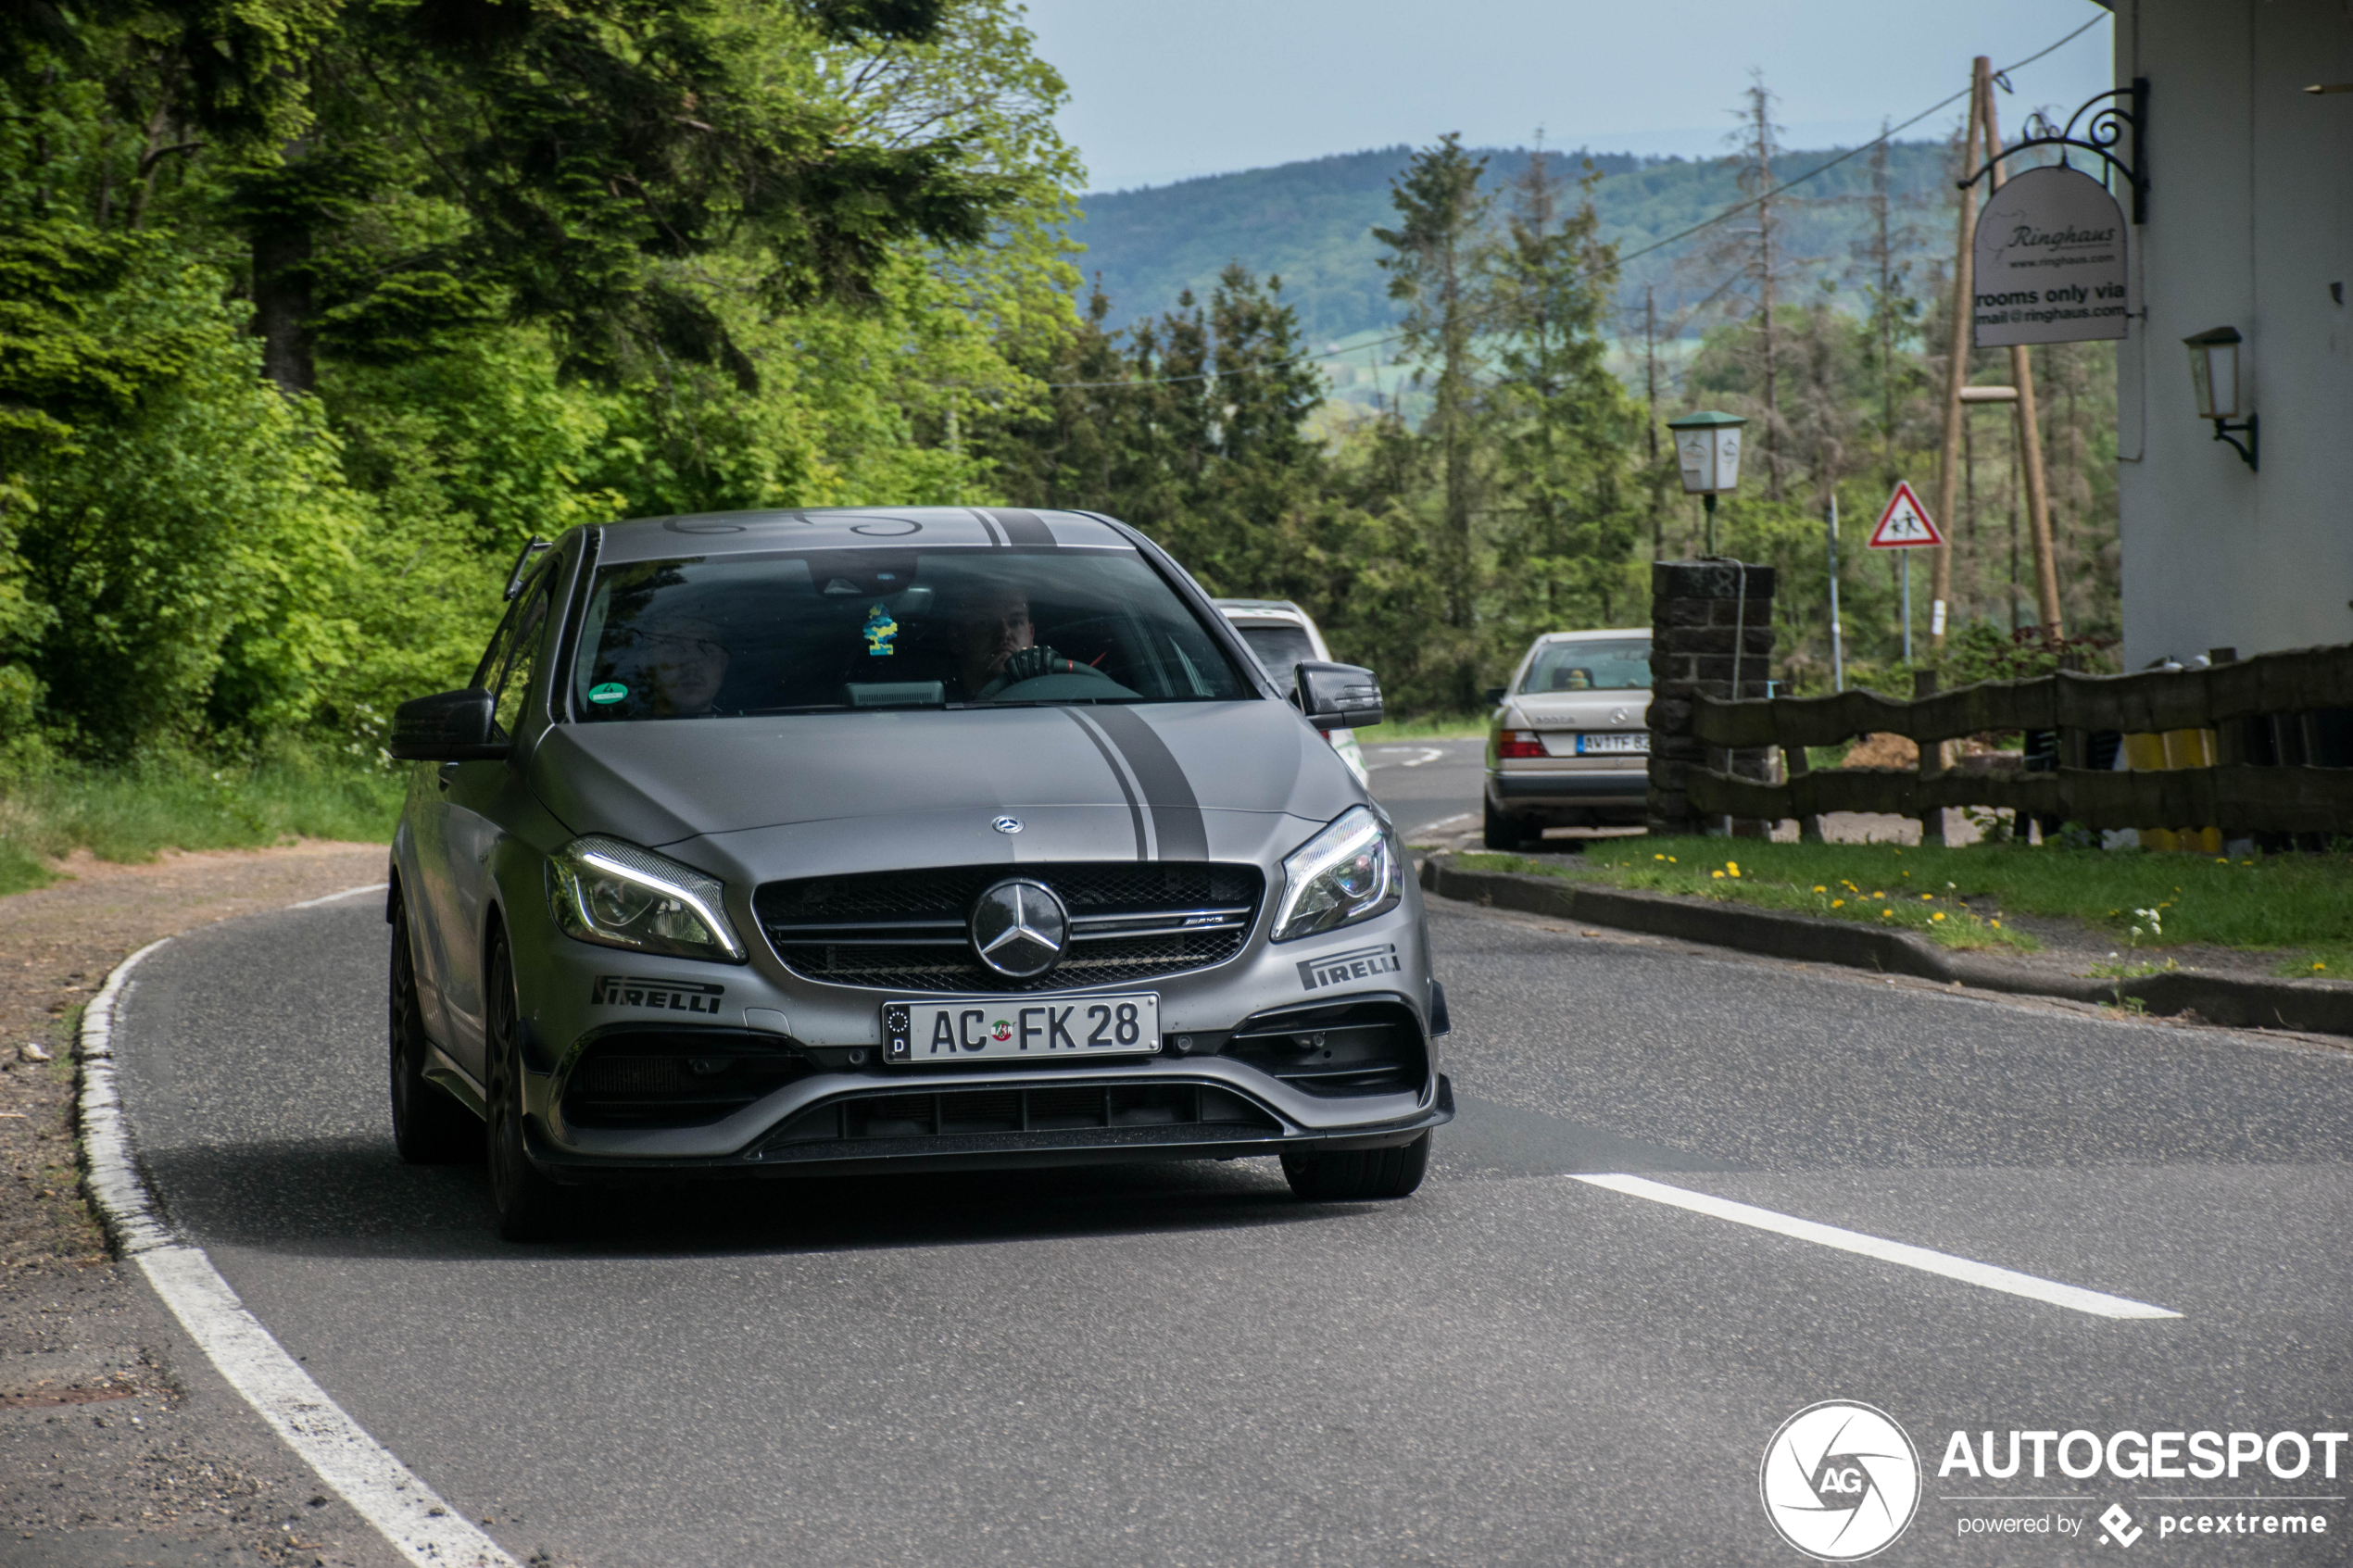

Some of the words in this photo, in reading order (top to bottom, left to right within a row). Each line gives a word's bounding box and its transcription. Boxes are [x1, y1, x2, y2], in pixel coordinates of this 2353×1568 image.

[2007, 225, 2115, 251] Ringhaus
[2009, 255, 2116, 269] www.ringhaus.com
[1976, 290, 2039, 307] rooms
[2045, 283, 2088, 304] only
[2095, 281, 2125, 299] via
[1295, 943, 1402, 991] PIRELLI
[591, 975, 724, 1015] PIRELLI
[930, 1009, 988, 1053] AC
[1018, 1005, 1076, 1050] FK
[1087, 1001, 1140, 1047] 28
[893, 1039, 904, 1052] D
